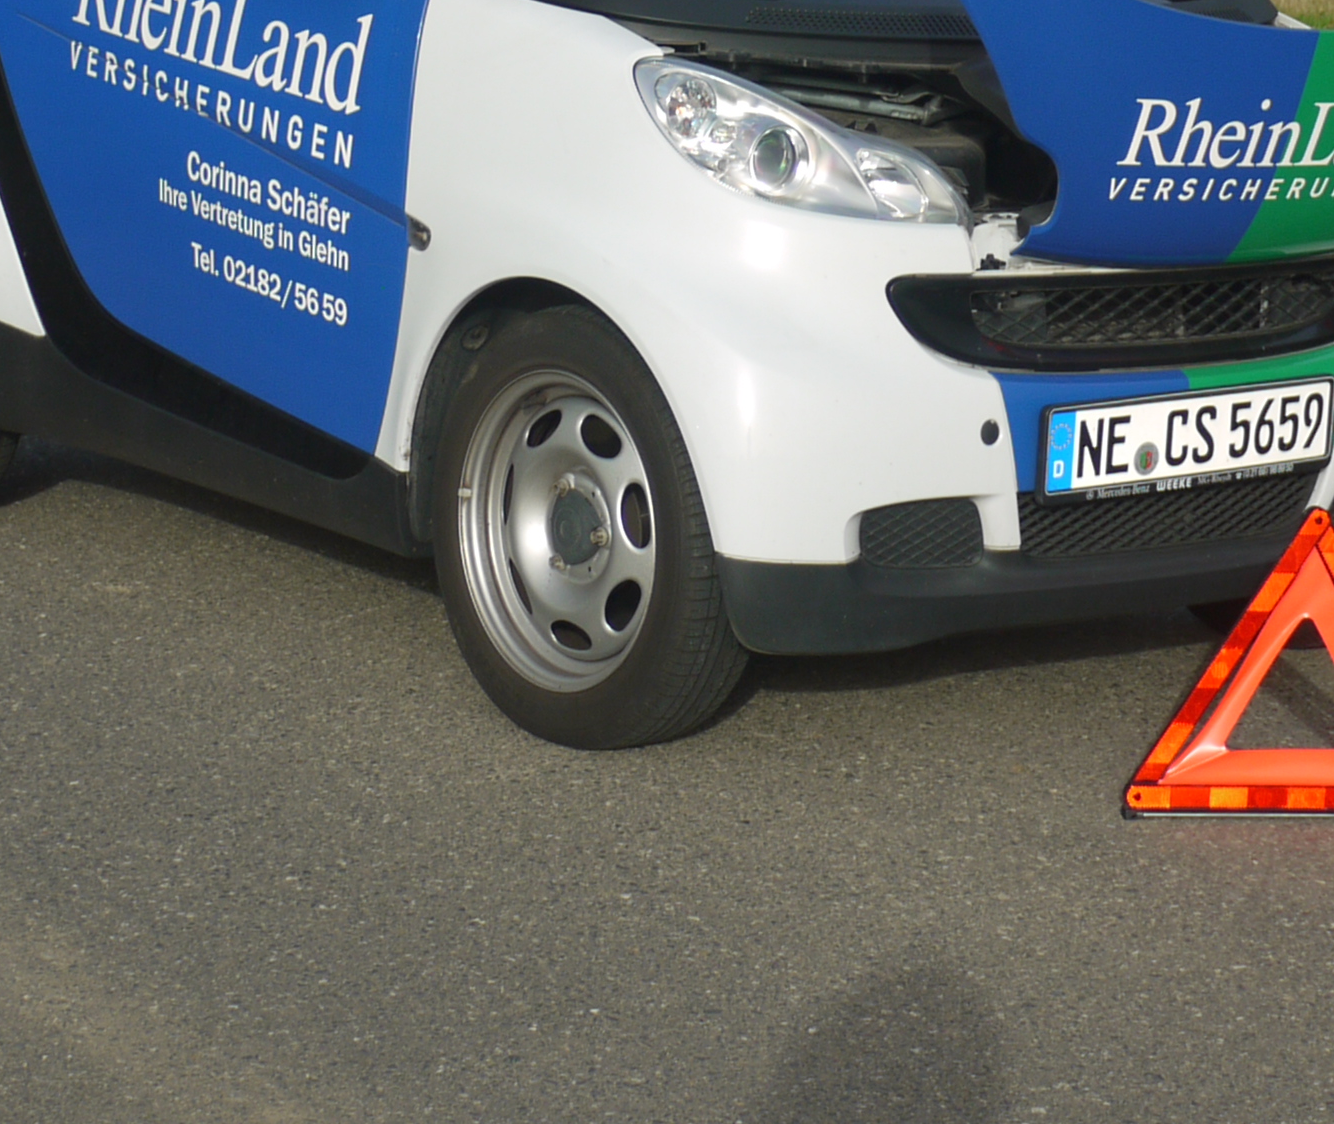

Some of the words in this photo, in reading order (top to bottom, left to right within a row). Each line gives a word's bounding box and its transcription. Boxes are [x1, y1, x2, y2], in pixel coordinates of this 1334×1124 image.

[70, 40, 354, 169] VERSICHERUNGEN
[159, 178, 188, 211] Ihre
[191, 190, 274, 249] Vertretung
[278, 222, 294, 252] in
[298, 230, 350, 272] Glehn
[187, 150, 262, 205] Corinna
[267, 179, 351, 235] Schäfer
[191, 241, 219, 277] Tel.
[1053, 460, 1064, 478] D
[1077, 414, 1131, 479] NE
[1165, 405, 1217, 466] CS
[1229, 392, 1324, 458] 5659
[1156, 477, 1192, 492] WEEKE
